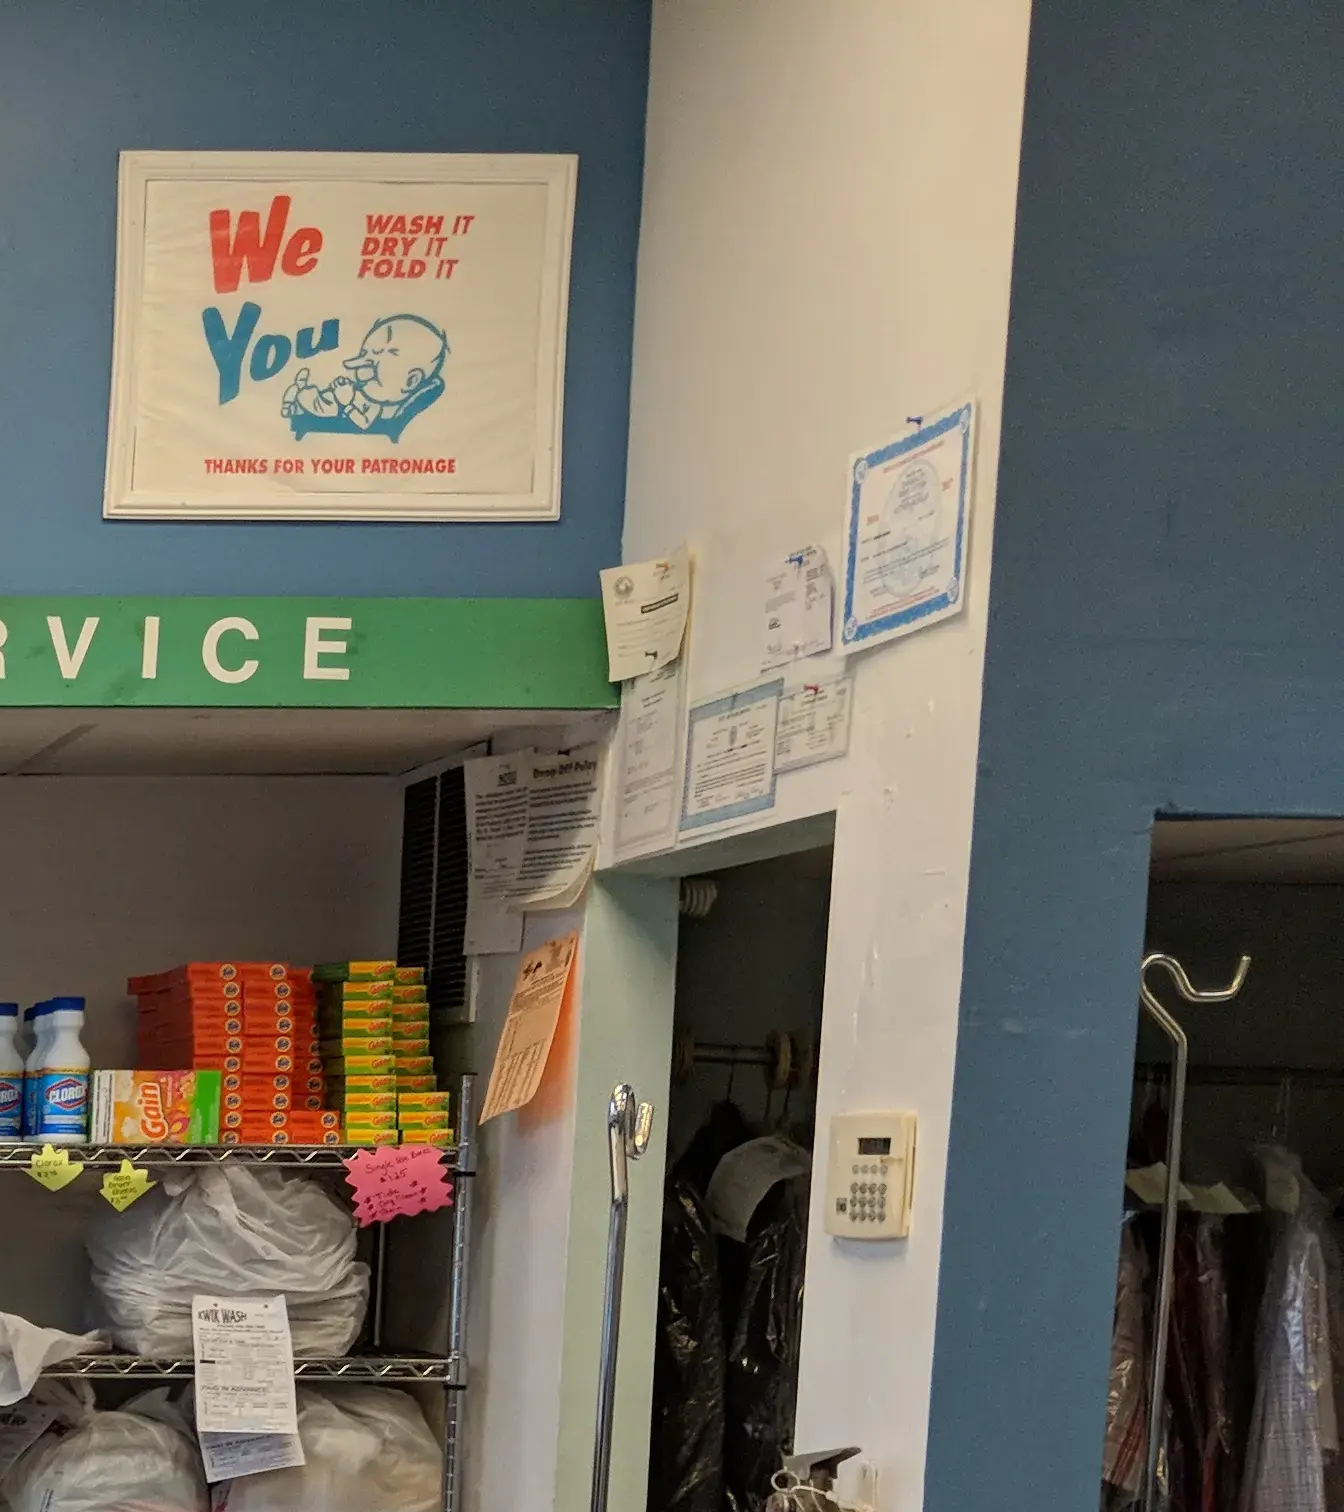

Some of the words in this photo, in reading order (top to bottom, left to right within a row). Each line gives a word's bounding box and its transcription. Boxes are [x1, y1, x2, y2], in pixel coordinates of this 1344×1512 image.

[366, 215, 442, 235] WASH
[452, 215, 475, 234] IT
[209, 196, 323, 294] We
[361, 237, 417, 257] DRY
[425, 237, 448, 257] IT
[358, 260, 426, 279] FOLD
[435, 260, 459, 279] IT
[202, 301, 340, 405] You
[204, 459, 268, 475] THANKS
[274, 459, 305, 475] FOR
[311, 459, 355, 475] YOUR
[361, 459, 456, 475] PATRONAGE
[48, 1084, 86, 1104] CLOROX
[139, 1082, 168, 1140] Gain
[198, 1309, 221, 1322] KWIK
[222, 1310, 247, 1323] WASH
